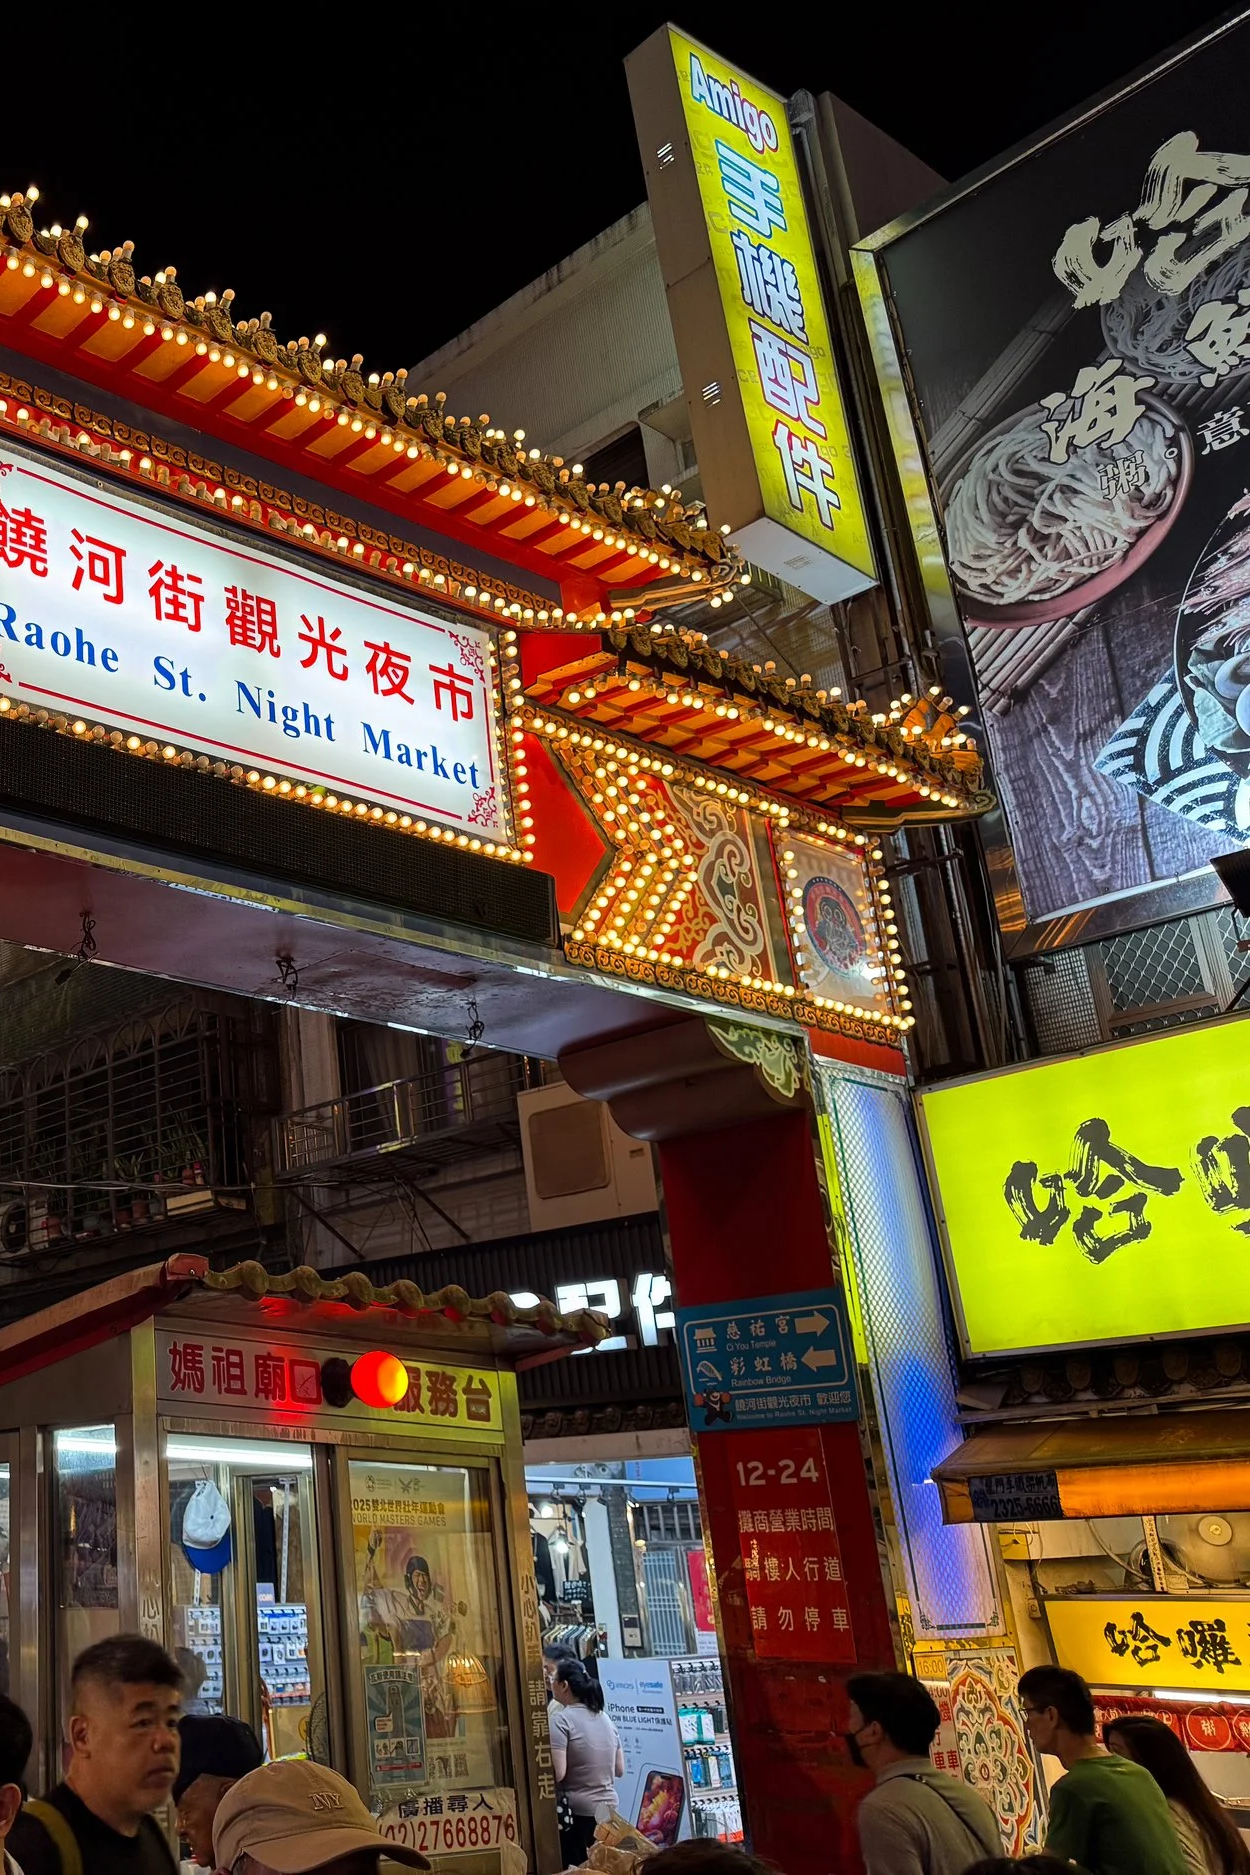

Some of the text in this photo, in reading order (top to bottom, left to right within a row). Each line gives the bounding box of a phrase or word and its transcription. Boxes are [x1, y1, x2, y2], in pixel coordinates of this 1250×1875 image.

[689, 52, 779, 154] Amigo
[715, 139, 841, 531] 手機配件
[1099, 450, 1149, 500] 粥
[153, 655, 207, 702] St.
[235, 680, 336, 742] Night
[361, 721, 481, 790] Market
[726, 1315, 791, 1340] 慈祐宮
[735, 1341, 750, 1351] You
[751, 1340, 777, 1350] Temple
[168, 1340, 323, 1405] 媽祖廟口
[729, 1352, 797, 1376] 彩虹橋
[731, 1375, 792, 1388] Rainbow Bridge
[736, 1457, 819, 1487] 12-24
[380, 1515, 415, 1526] MASTERS
[417, 1516, 447, 1527] GAMES
[738, 1506, 834, 1534] 攤商營業時間
[744, 1556, 843, 1582] 騎樓人行道
[750, 1606, 850, 1632] 請勿停車
[1104, 1611, 1243, 1675] 哈囉
[918, 1658, 944, 1675] 16:00
[607, 1702, 635, 1713] iPhone
[622, 1715, 637, 1723] BLUE
[528, 1679, 556, 1801] 請靠右走
[398, 1793, 494, 1819] 廣播尋人
